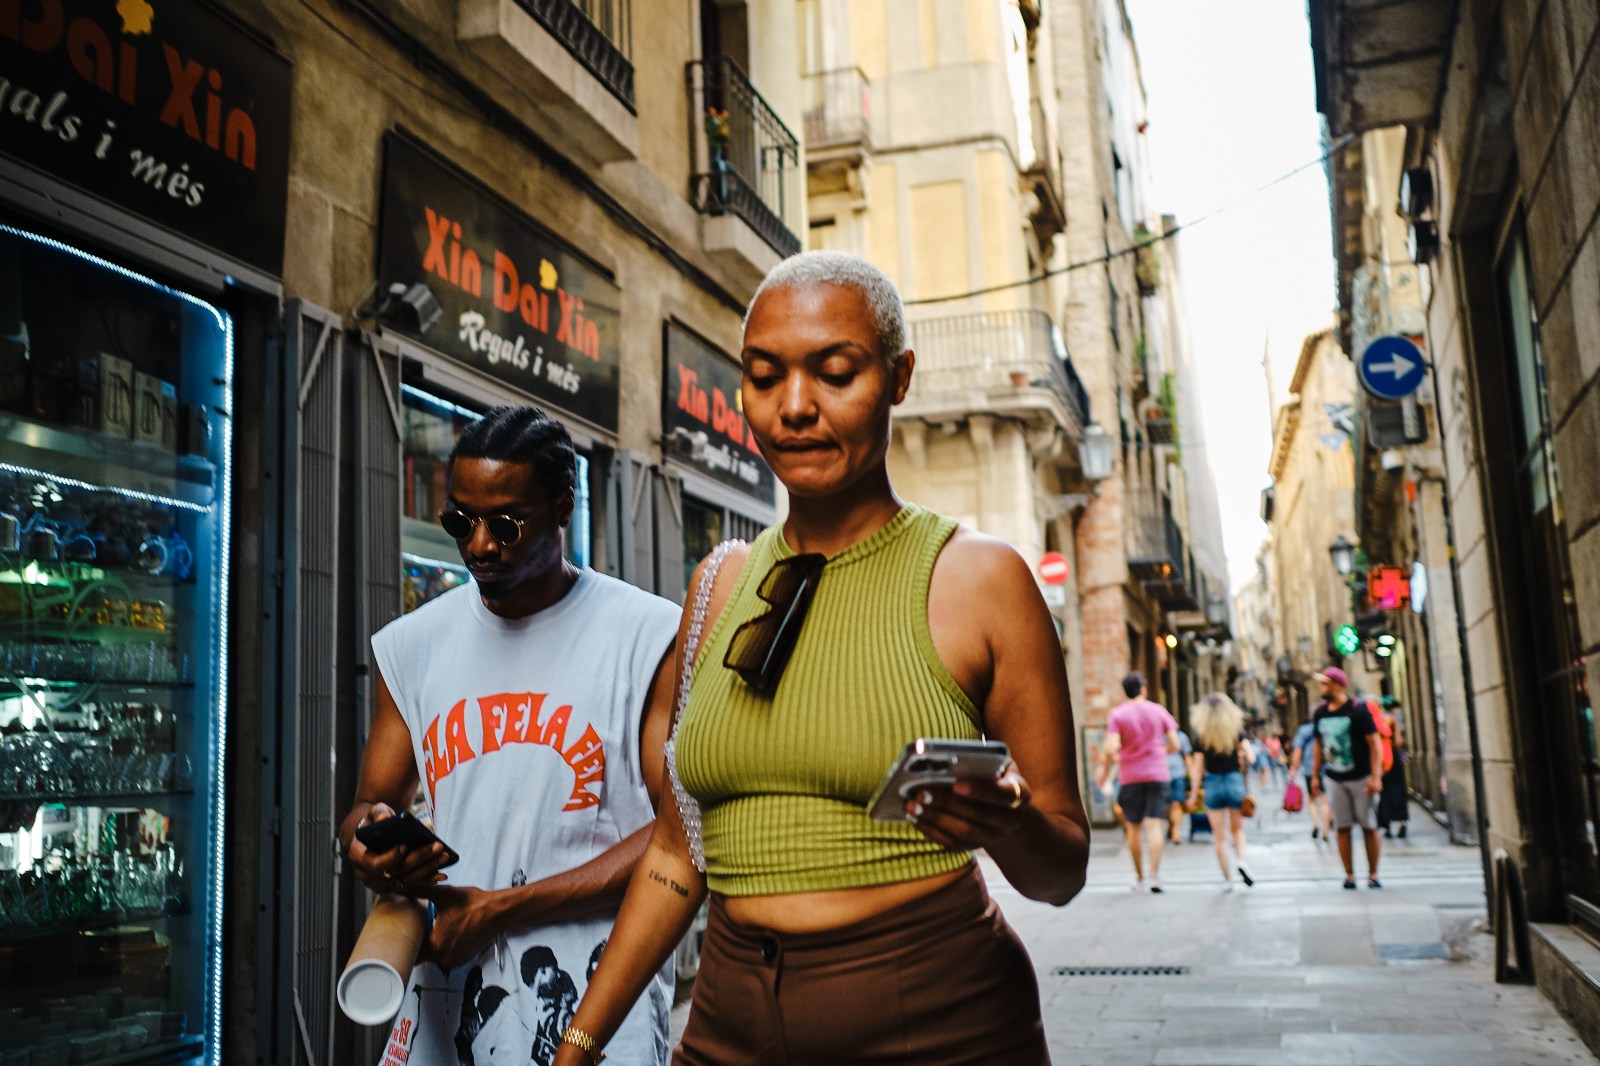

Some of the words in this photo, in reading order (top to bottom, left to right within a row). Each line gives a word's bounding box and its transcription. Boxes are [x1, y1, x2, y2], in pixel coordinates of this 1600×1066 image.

[94, 117, 117, 160] i
[159, 41, 257, 172] Xin
[422, 206, 482, 298] Xin
[493, 249, 549, 334] Dai
[556, 286, 600, 362] Xin
[458, 310, 530, 369] Regals
[532, 346, 544, 376] i
[677, 362, 709, 424] Xin
[712, 386, 744, 446] Dai
[476, 690, 573, 756] FELA
[561, 722, 606, 812] FELA
